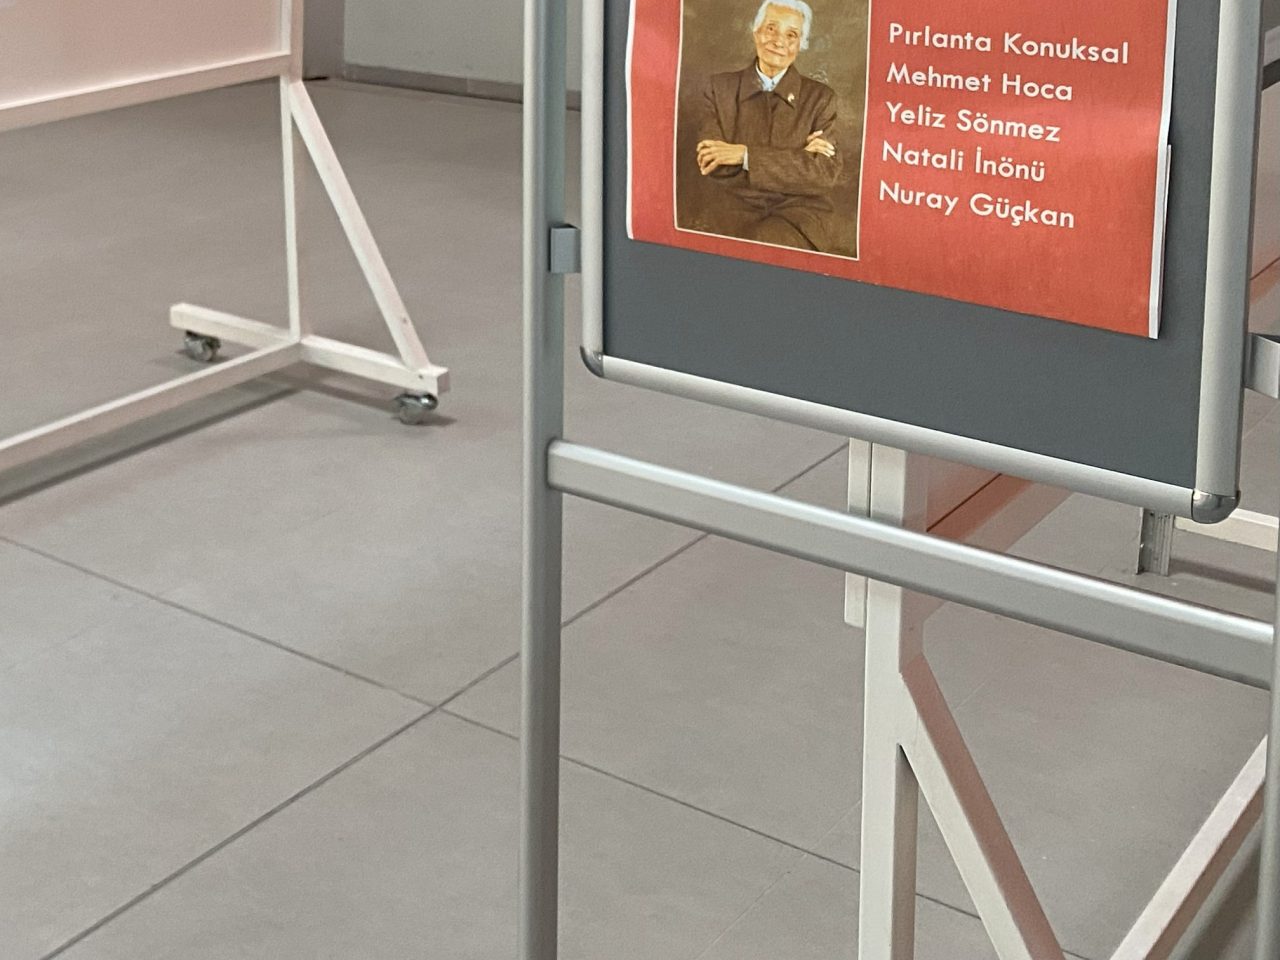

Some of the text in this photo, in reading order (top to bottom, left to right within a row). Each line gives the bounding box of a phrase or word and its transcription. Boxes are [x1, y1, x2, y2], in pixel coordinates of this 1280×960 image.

[889, 23, 1129, 64] Pırlanta Konuksal
[886, 62, 1073, 101] Mehmet Hoca
[886, 101, 1061, 142] Yeliz Sönmez
[882, 140, 1045, 182] Natali İnönü
[879, 180, 1074, 228] Nuray Güçkan
